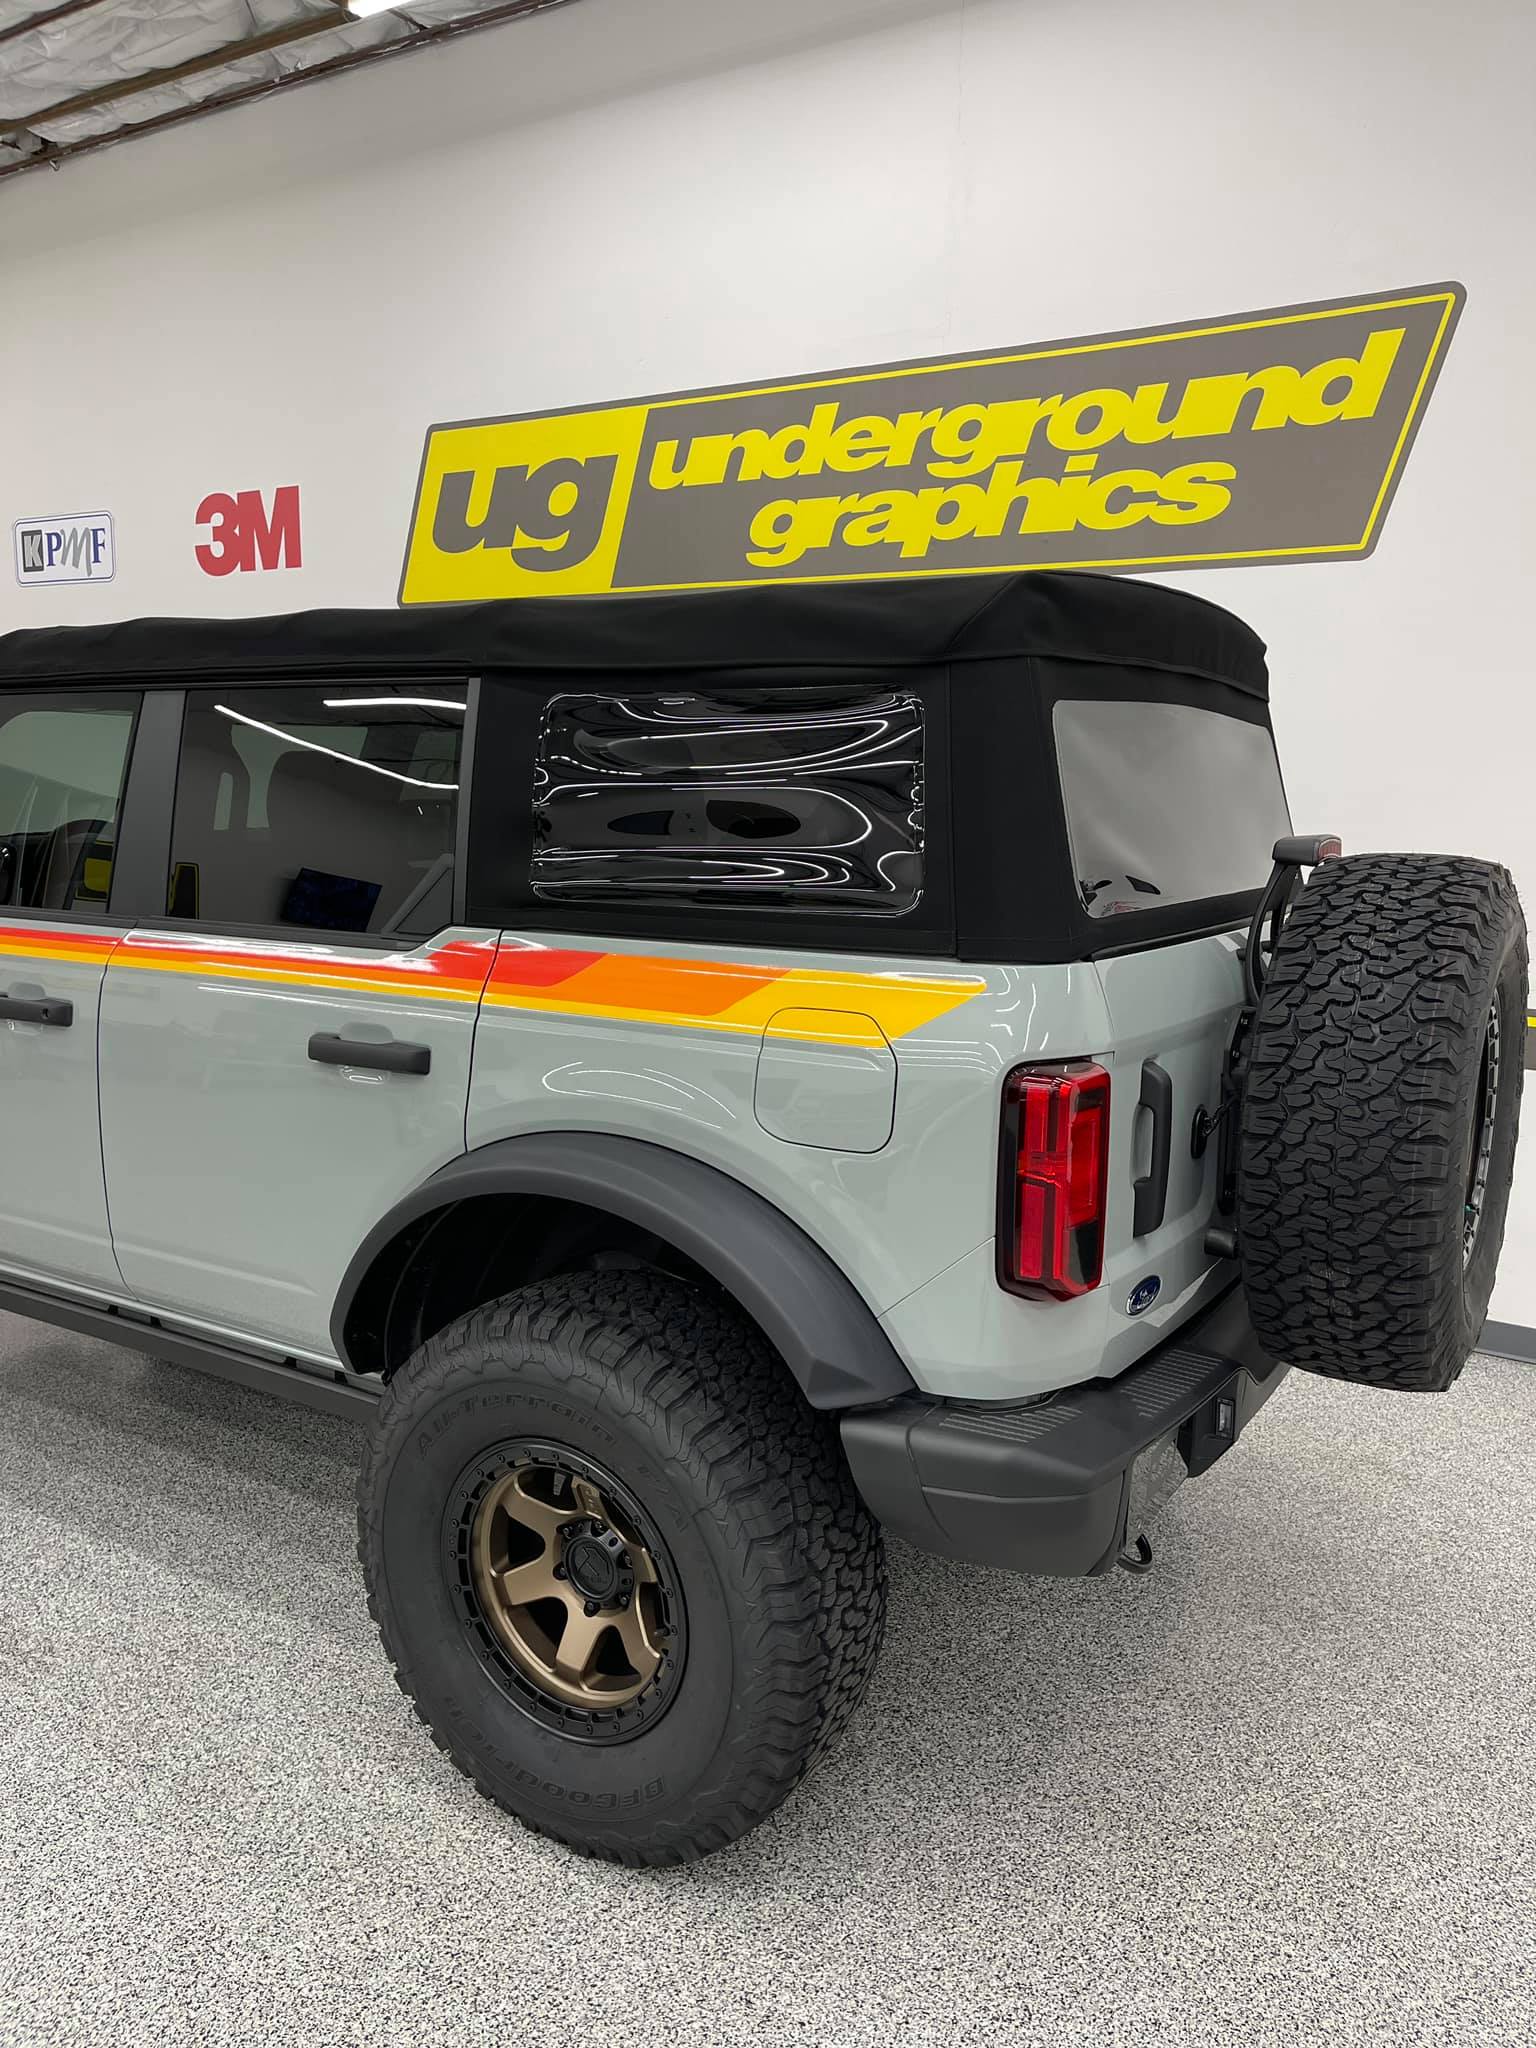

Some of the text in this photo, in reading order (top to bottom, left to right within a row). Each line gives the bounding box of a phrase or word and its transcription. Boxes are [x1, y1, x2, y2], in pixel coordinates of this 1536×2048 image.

[649, 328, 1406, 490] underground
[21, 527, 106, 577] KPMF
[195, 486, 302, 576] 3M
[433, 453, 618, 573] ug
[746, 453, 1237, 567] graphics
